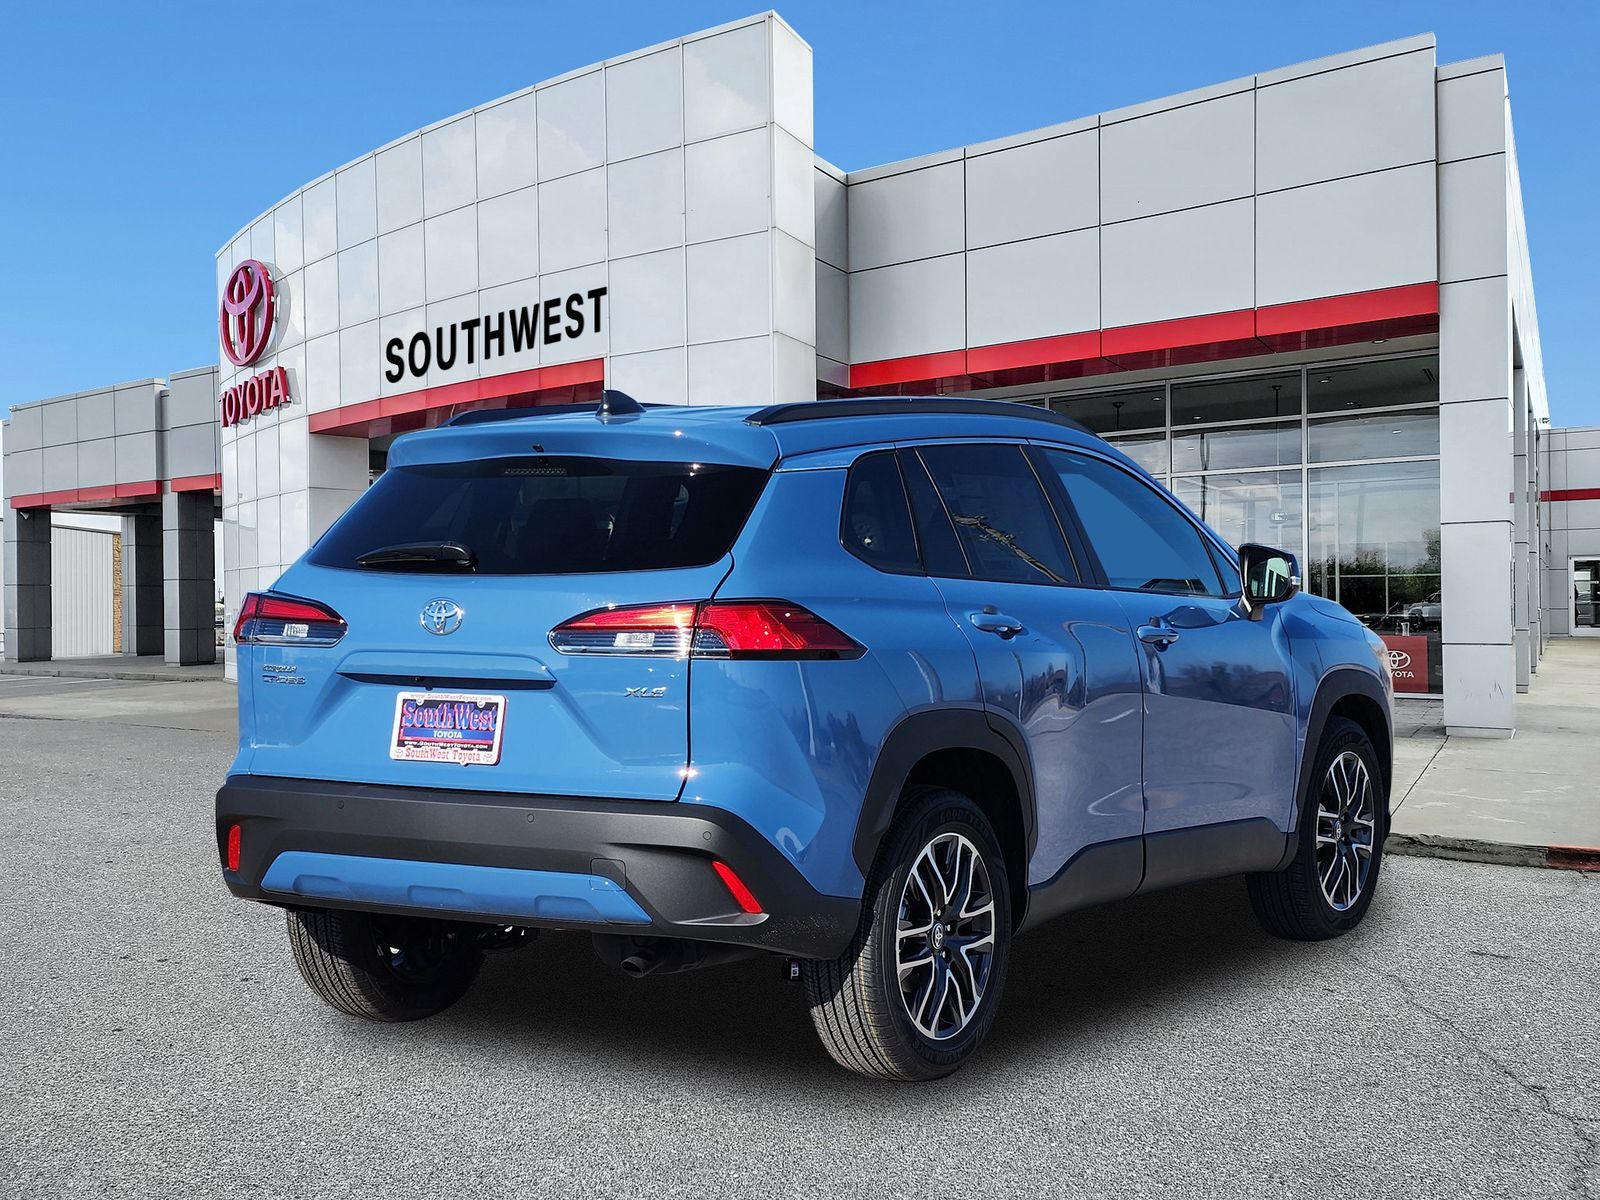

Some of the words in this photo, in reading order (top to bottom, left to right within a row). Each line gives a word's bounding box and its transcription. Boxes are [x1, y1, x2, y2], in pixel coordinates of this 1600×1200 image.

[386, 287, 607, 383] SOUTHWEST
[218, 366, 287, 427] TOYOTA
[624, 687, 666, 698] XLE
[401, 701, 497, 732] SouthWest
[433, 731, 463, 739] TOYOTA
[405, 748, 449, 760] SouthWest
[452, 750, 480, 763] Toyota
